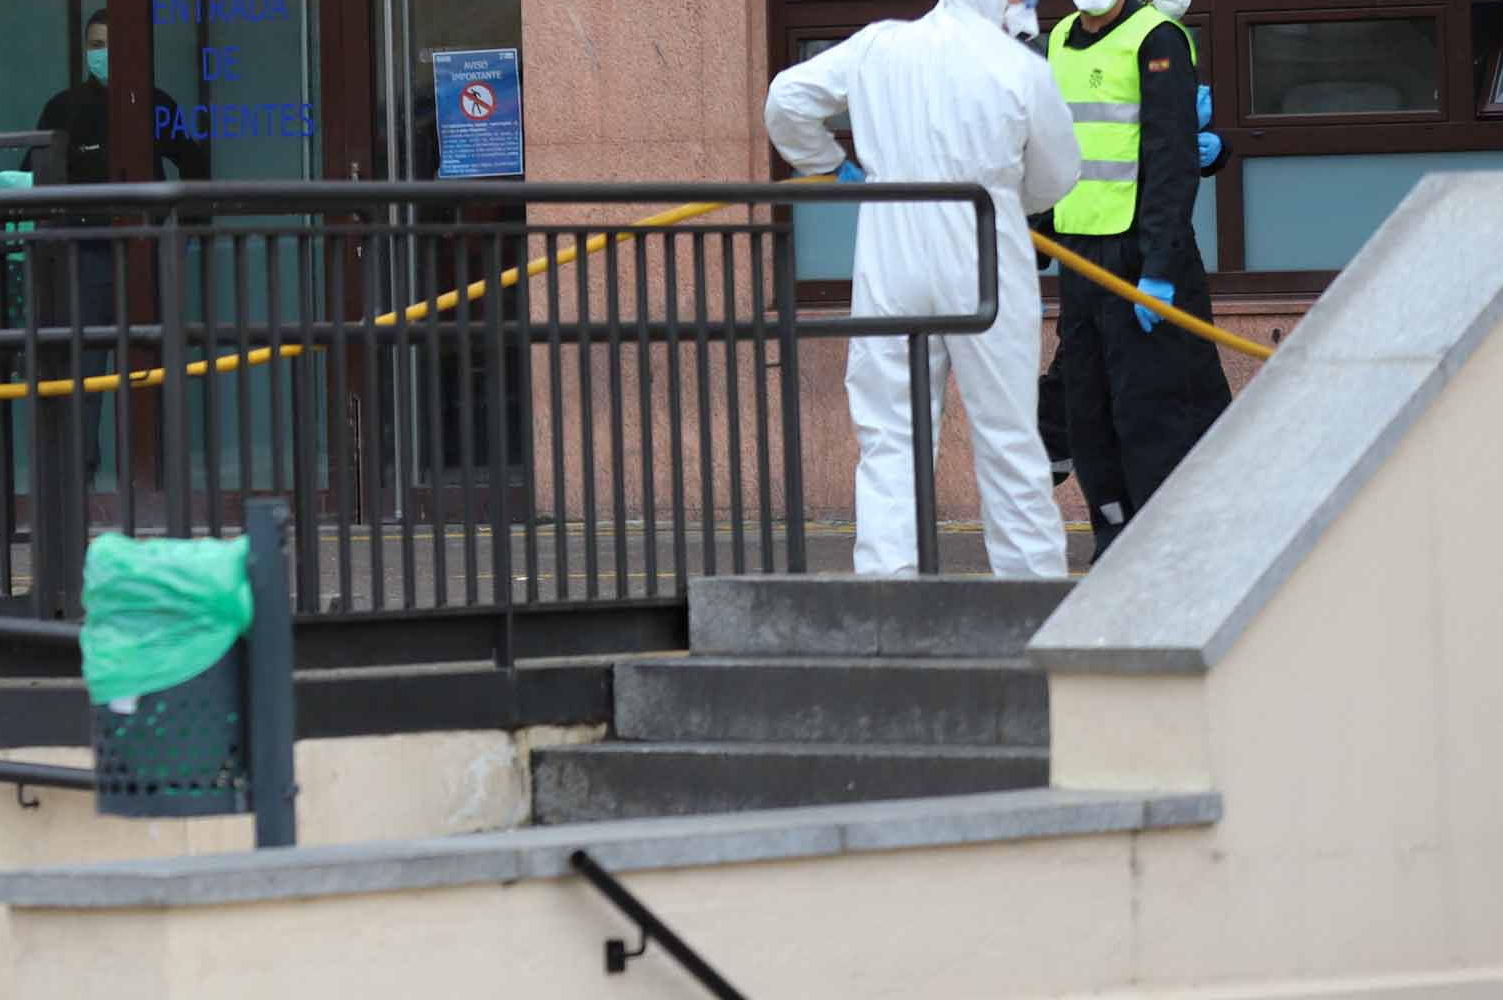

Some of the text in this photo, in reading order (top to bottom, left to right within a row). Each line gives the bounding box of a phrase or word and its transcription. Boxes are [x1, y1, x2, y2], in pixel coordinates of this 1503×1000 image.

[202, 45, 242, 82] DE
[451, 70, 503, 81] IMPORTANTE
[463, 61, 488, 70] AVISO
[154, 103, 315, 141] PACIENTES
